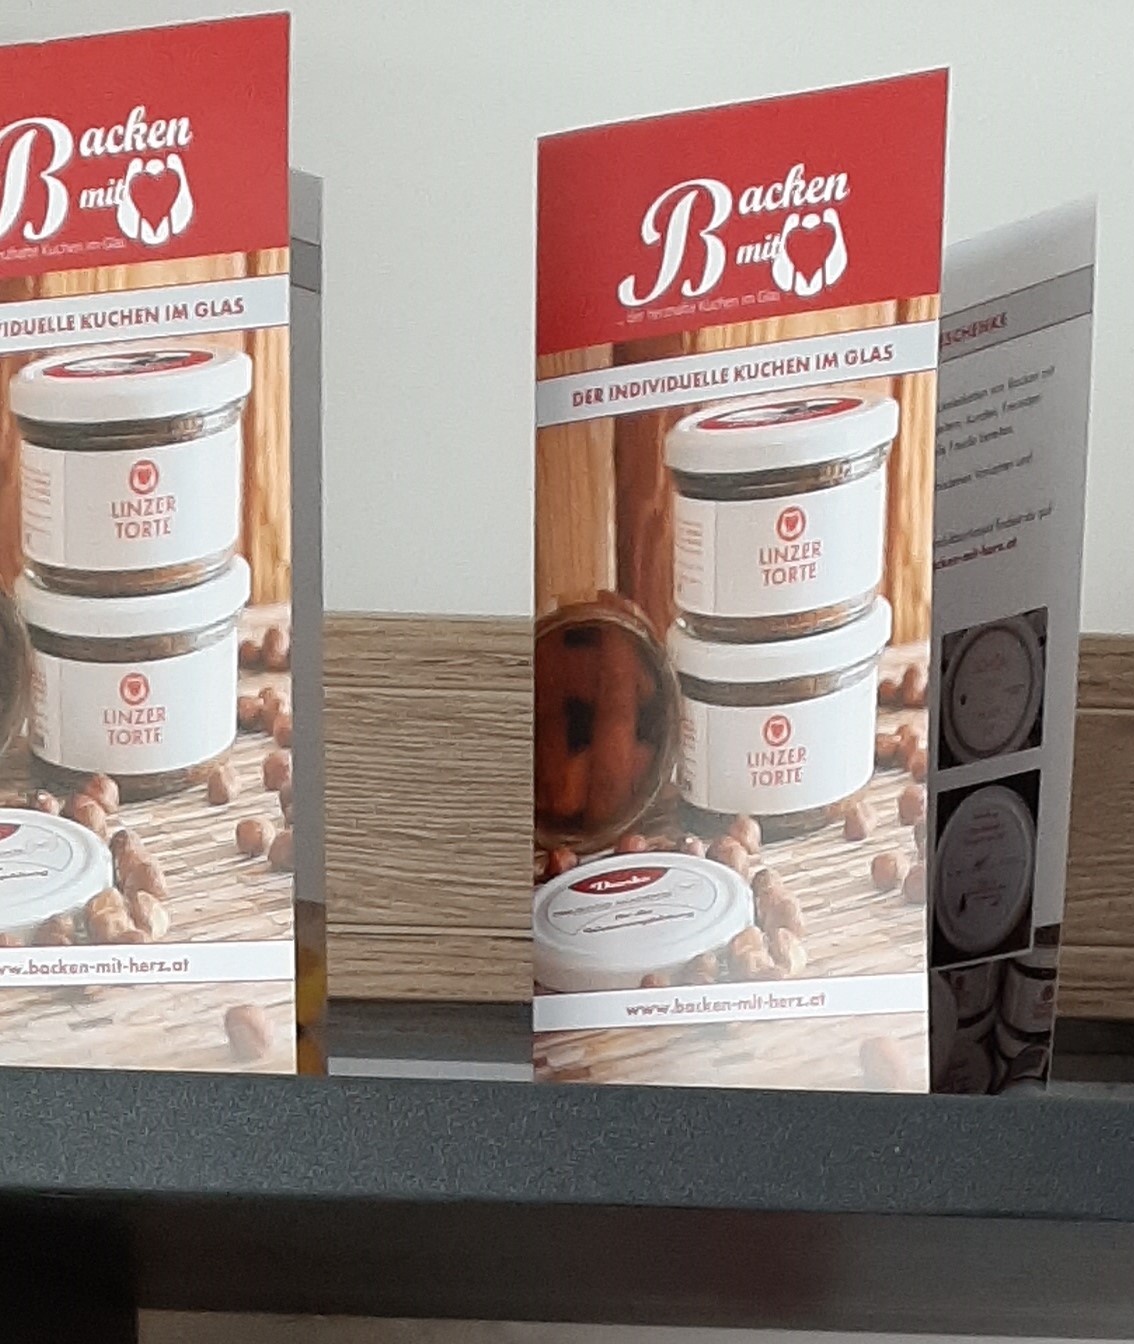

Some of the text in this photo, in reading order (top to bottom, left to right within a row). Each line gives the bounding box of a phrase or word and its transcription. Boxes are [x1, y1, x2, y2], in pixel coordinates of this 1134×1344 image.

[79, 178, 127, 209] mit
[618, 163, 850, 307] Backen
[736, 234, 783, 266] mit
[80, 306, 159, 329] KUCHEN
[166, 302, 189, 321] IM
[195, 297, 244, 317] GLAS
[572, 344, 894, 407] DER INDIVIDUELLE KUCHEN IM GLAS
[110, 496, 176, 519] LINZER
[115, 517, 171, 539] TORTE
[759, 541, 821, 566] LINZER
[762, 562, 817, 587] TORTE
[103, 706, 166, 725] LINZER
[107, 728, 162, 746] TORTE
[746, 746, 806, 767] LINZER
[750, 768, 803, 788] TORTE
[626, 994, 826, 1017] www.backen-mit-herz.at
